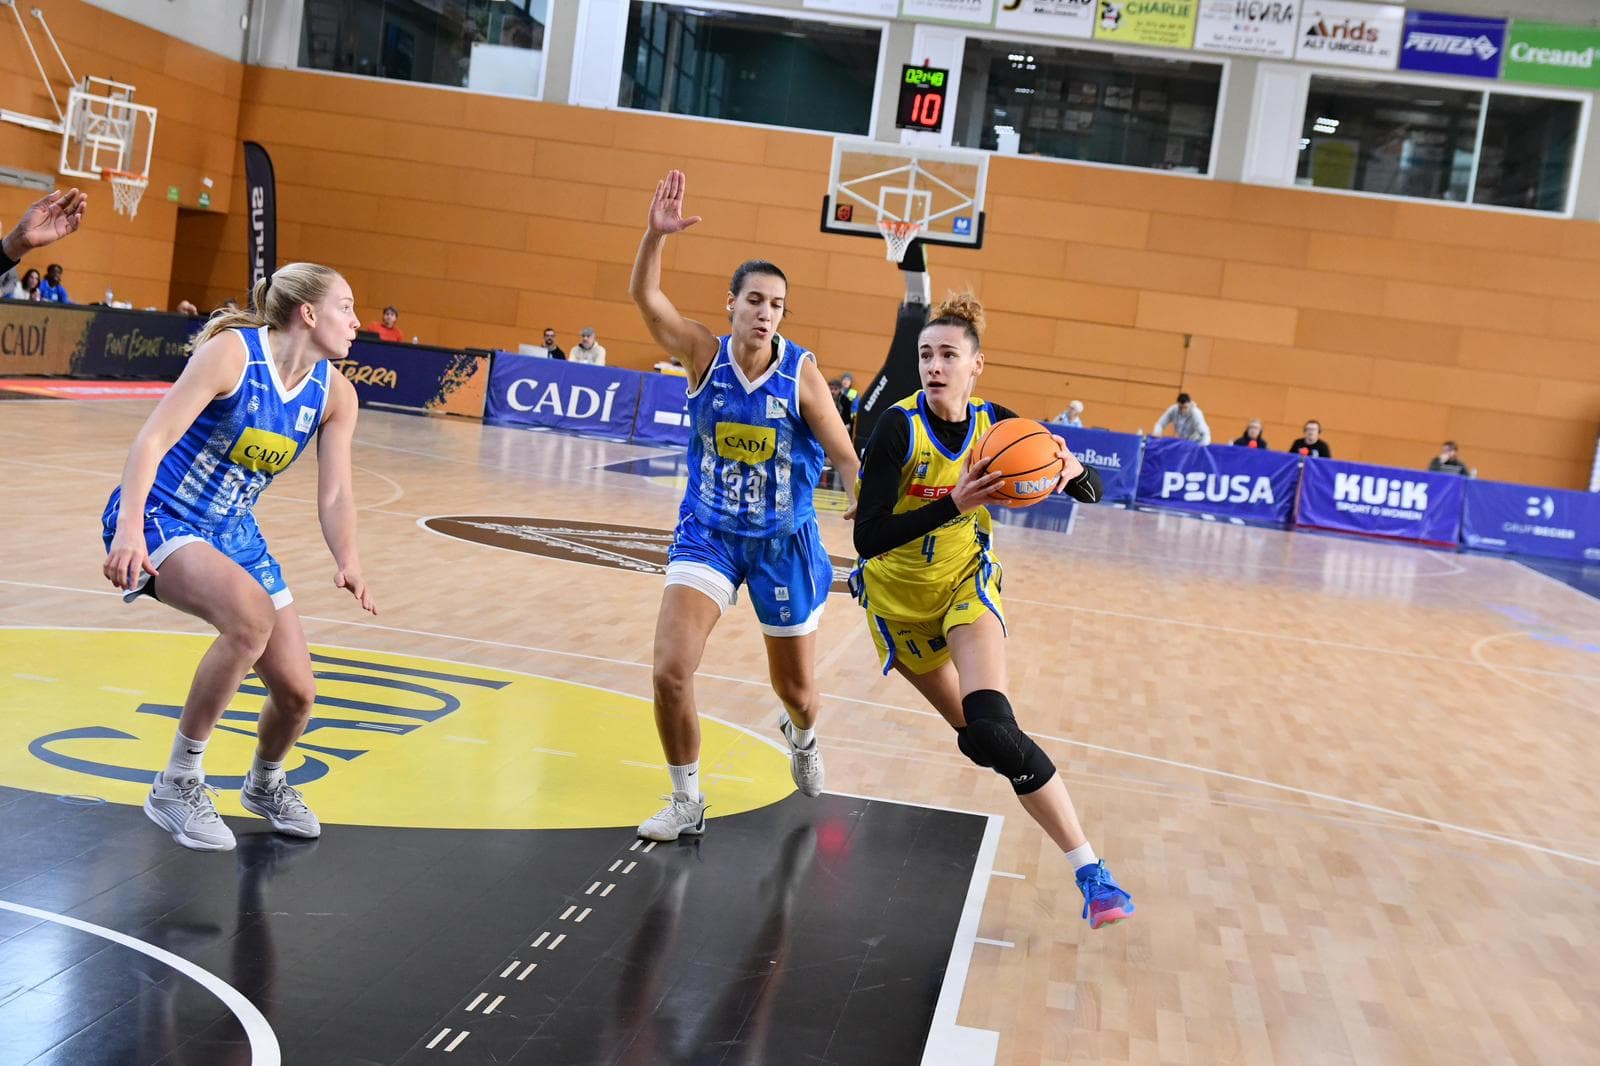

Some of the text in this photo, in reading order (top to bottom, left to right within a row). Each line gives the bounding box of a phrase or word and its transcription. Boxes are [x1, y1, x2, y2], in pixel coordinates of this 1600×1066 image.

[1306, 19, 1378, 42] Arids
[1511, 42, 1595, 68] Creand
[911, 93, 942, 126] 10
[1, 316, 49, 357] CADÍ
[506, 378, 621, 423] CADÍ
[244, 444, 289, 466] CADÍ
[724, 436, 768, 453] CADÍ
[726, 473, 763, 503] 33
[923, 488, 956, 497] SP
[1161, 471, 1275, 505] PEUSA
[922, 533, 937, 564] 4
[905, 638, 922, 659] 4
